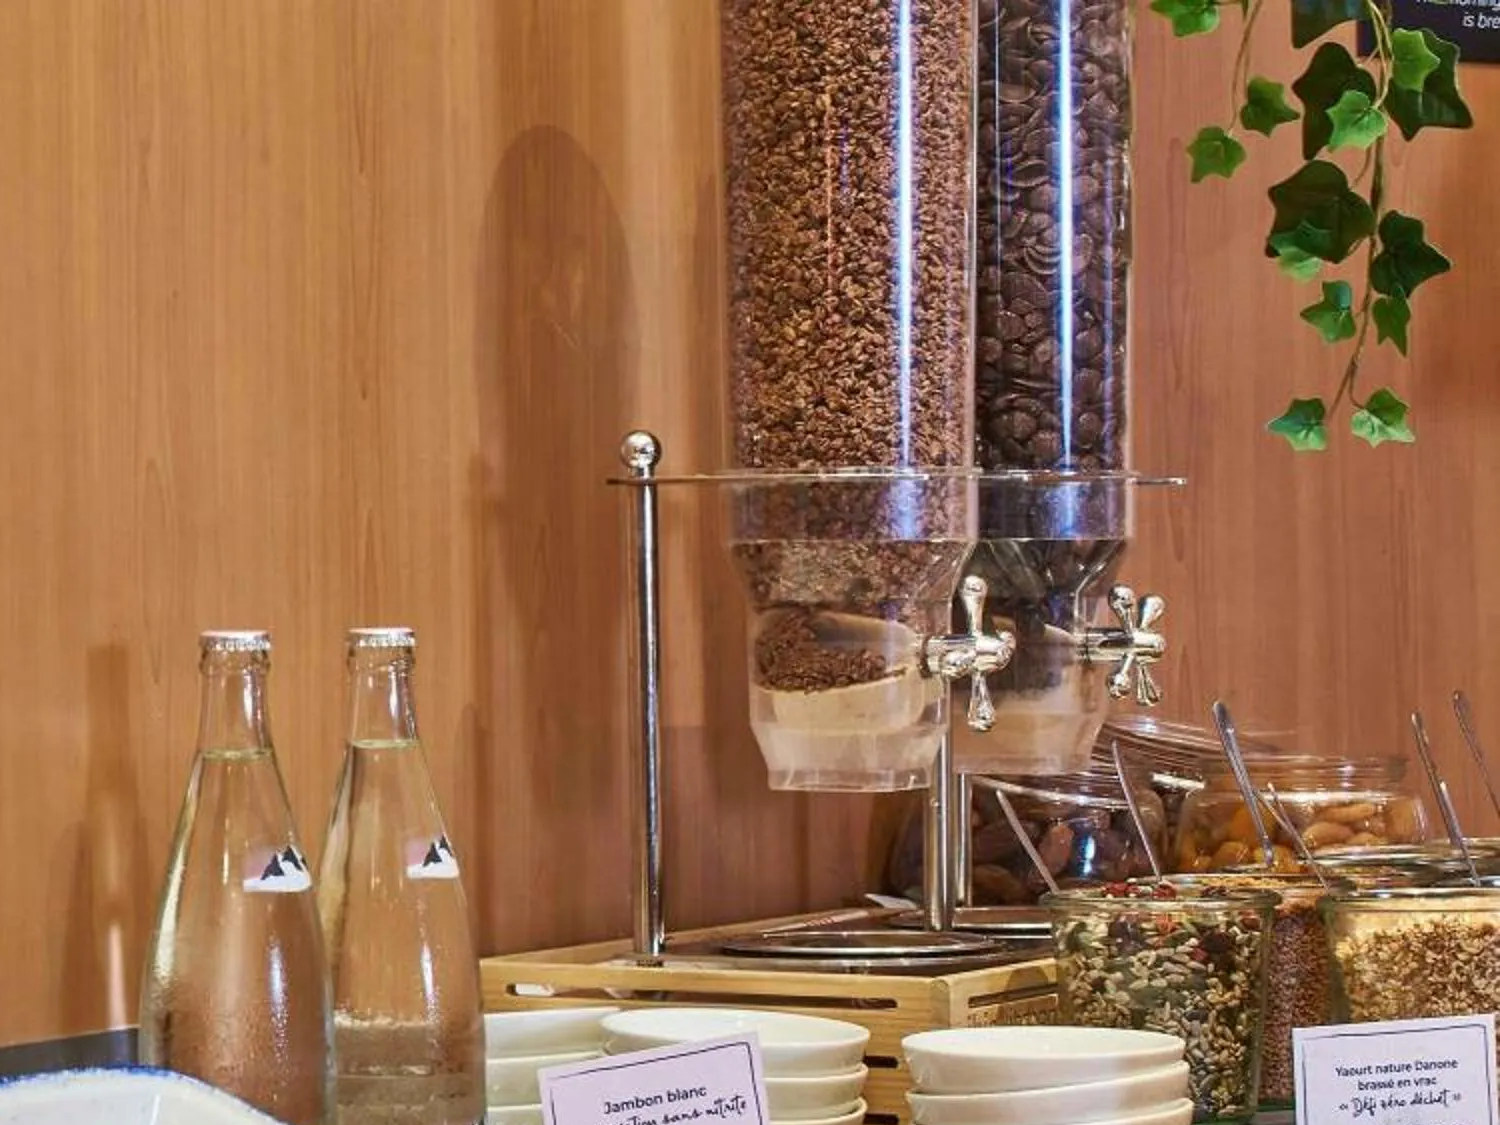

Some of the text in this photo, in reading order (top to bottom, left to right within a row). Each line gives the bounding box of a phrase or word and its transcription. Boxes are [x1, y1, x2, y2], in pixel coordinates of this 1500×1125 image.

[1463, 11, 1475, 27] is
[1335, 1059, 1458, 1077] Yaourt nature Danone
[1358, 1076, 1437, 1091] brassé en vrac
[604, 1086, 707, 1114] Jambon blanc
[662, 1107, 702, 1124] sans
[706, 1095, 747, 1119] nitrite
[1351, 1095, 1376, 1118] Défi
[1380, 1095, 1406, 1111] zéro
[1410, 1089, 1451, 1107] déchet
